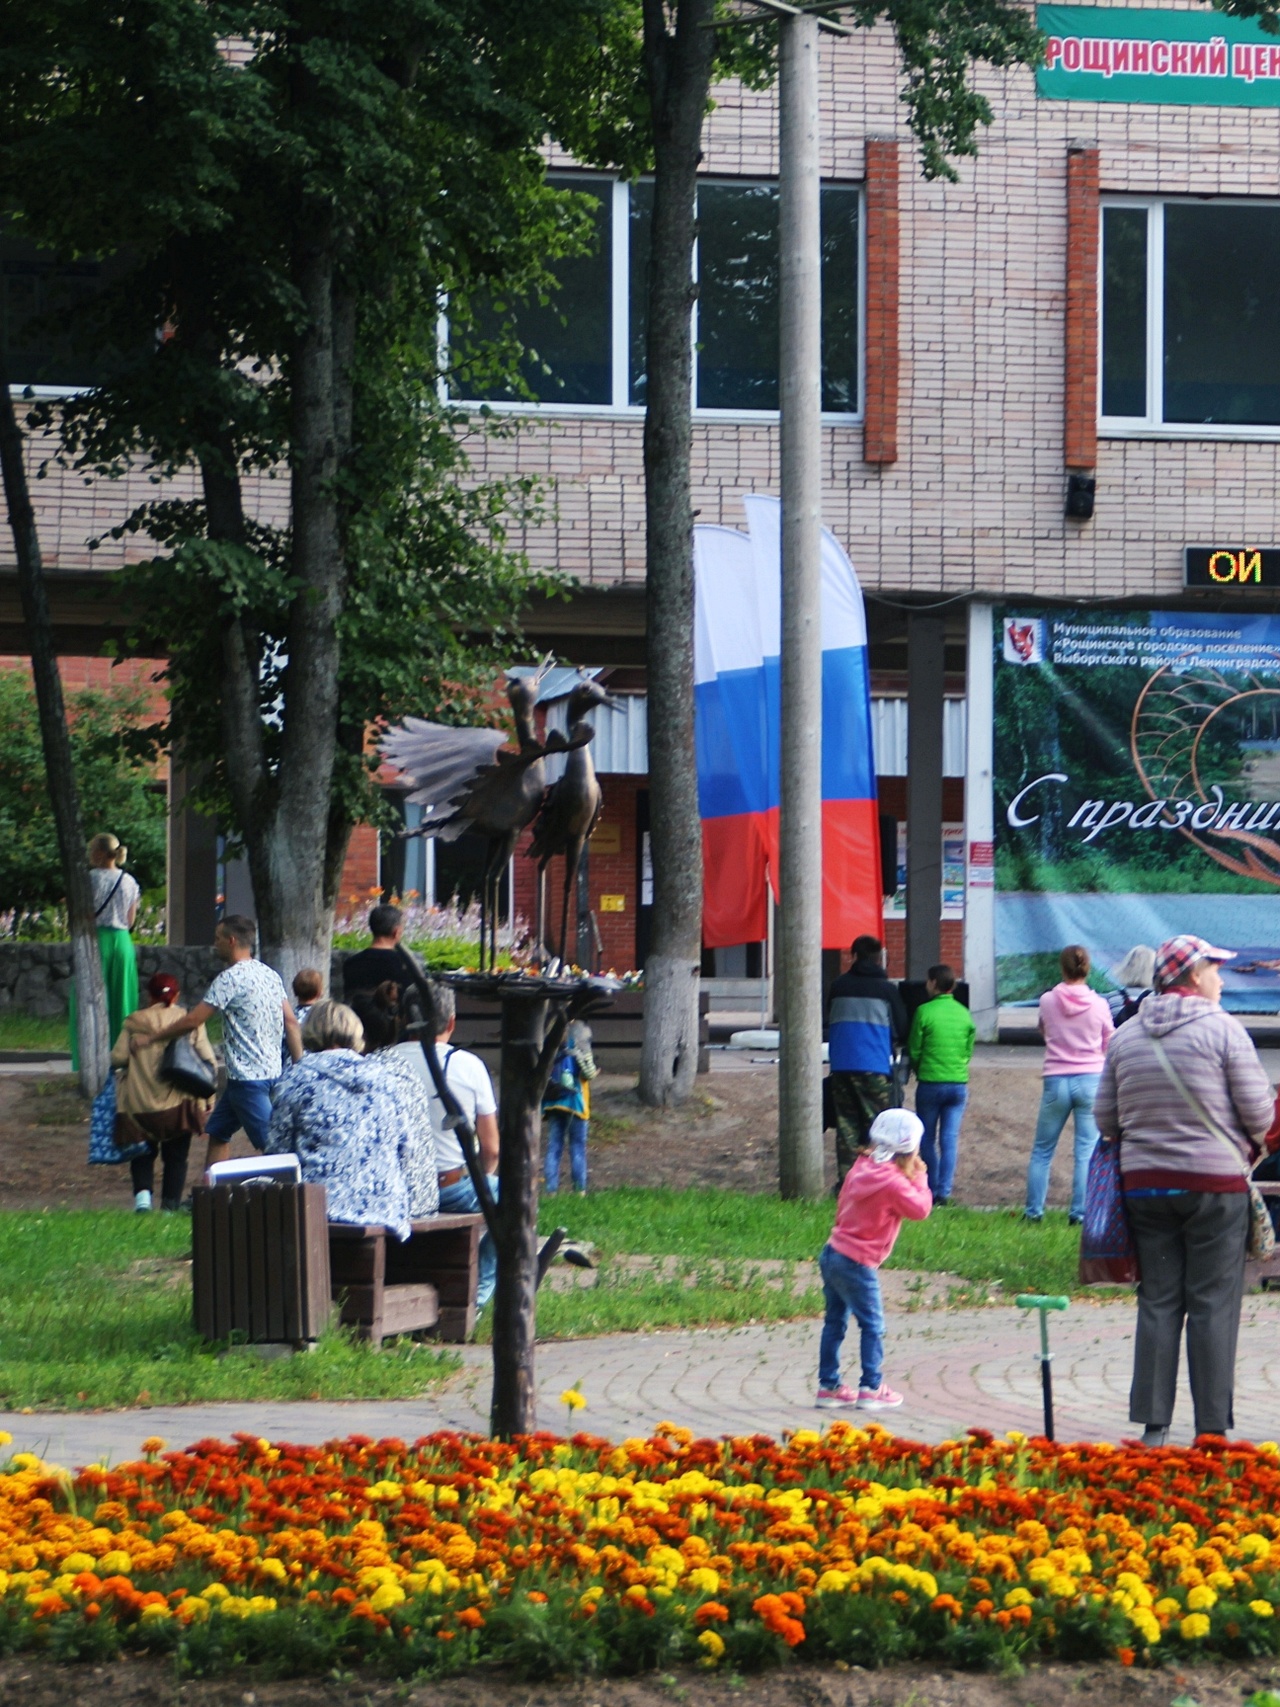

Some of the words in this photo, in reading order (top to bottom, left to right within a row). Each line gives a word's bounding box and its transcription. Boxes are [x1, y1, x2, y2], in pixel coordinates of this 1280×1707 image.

[1045, 36, 1228, 78] РОЩИНСКИЙ
[1208, 547, 1262, 584] ОЙ
[1053, 623, 1157, 639] Муниципальное
[1160, 627, 1242, 640] образование
[1053, 638, 1135, 651] «Рощинское
[1137, 641, 1203, 654] городское
[1053, 652, 1137, 667] Выборгского
[1140, 654, 1187, 668] района
[1006, 772, 1069, 828] С
